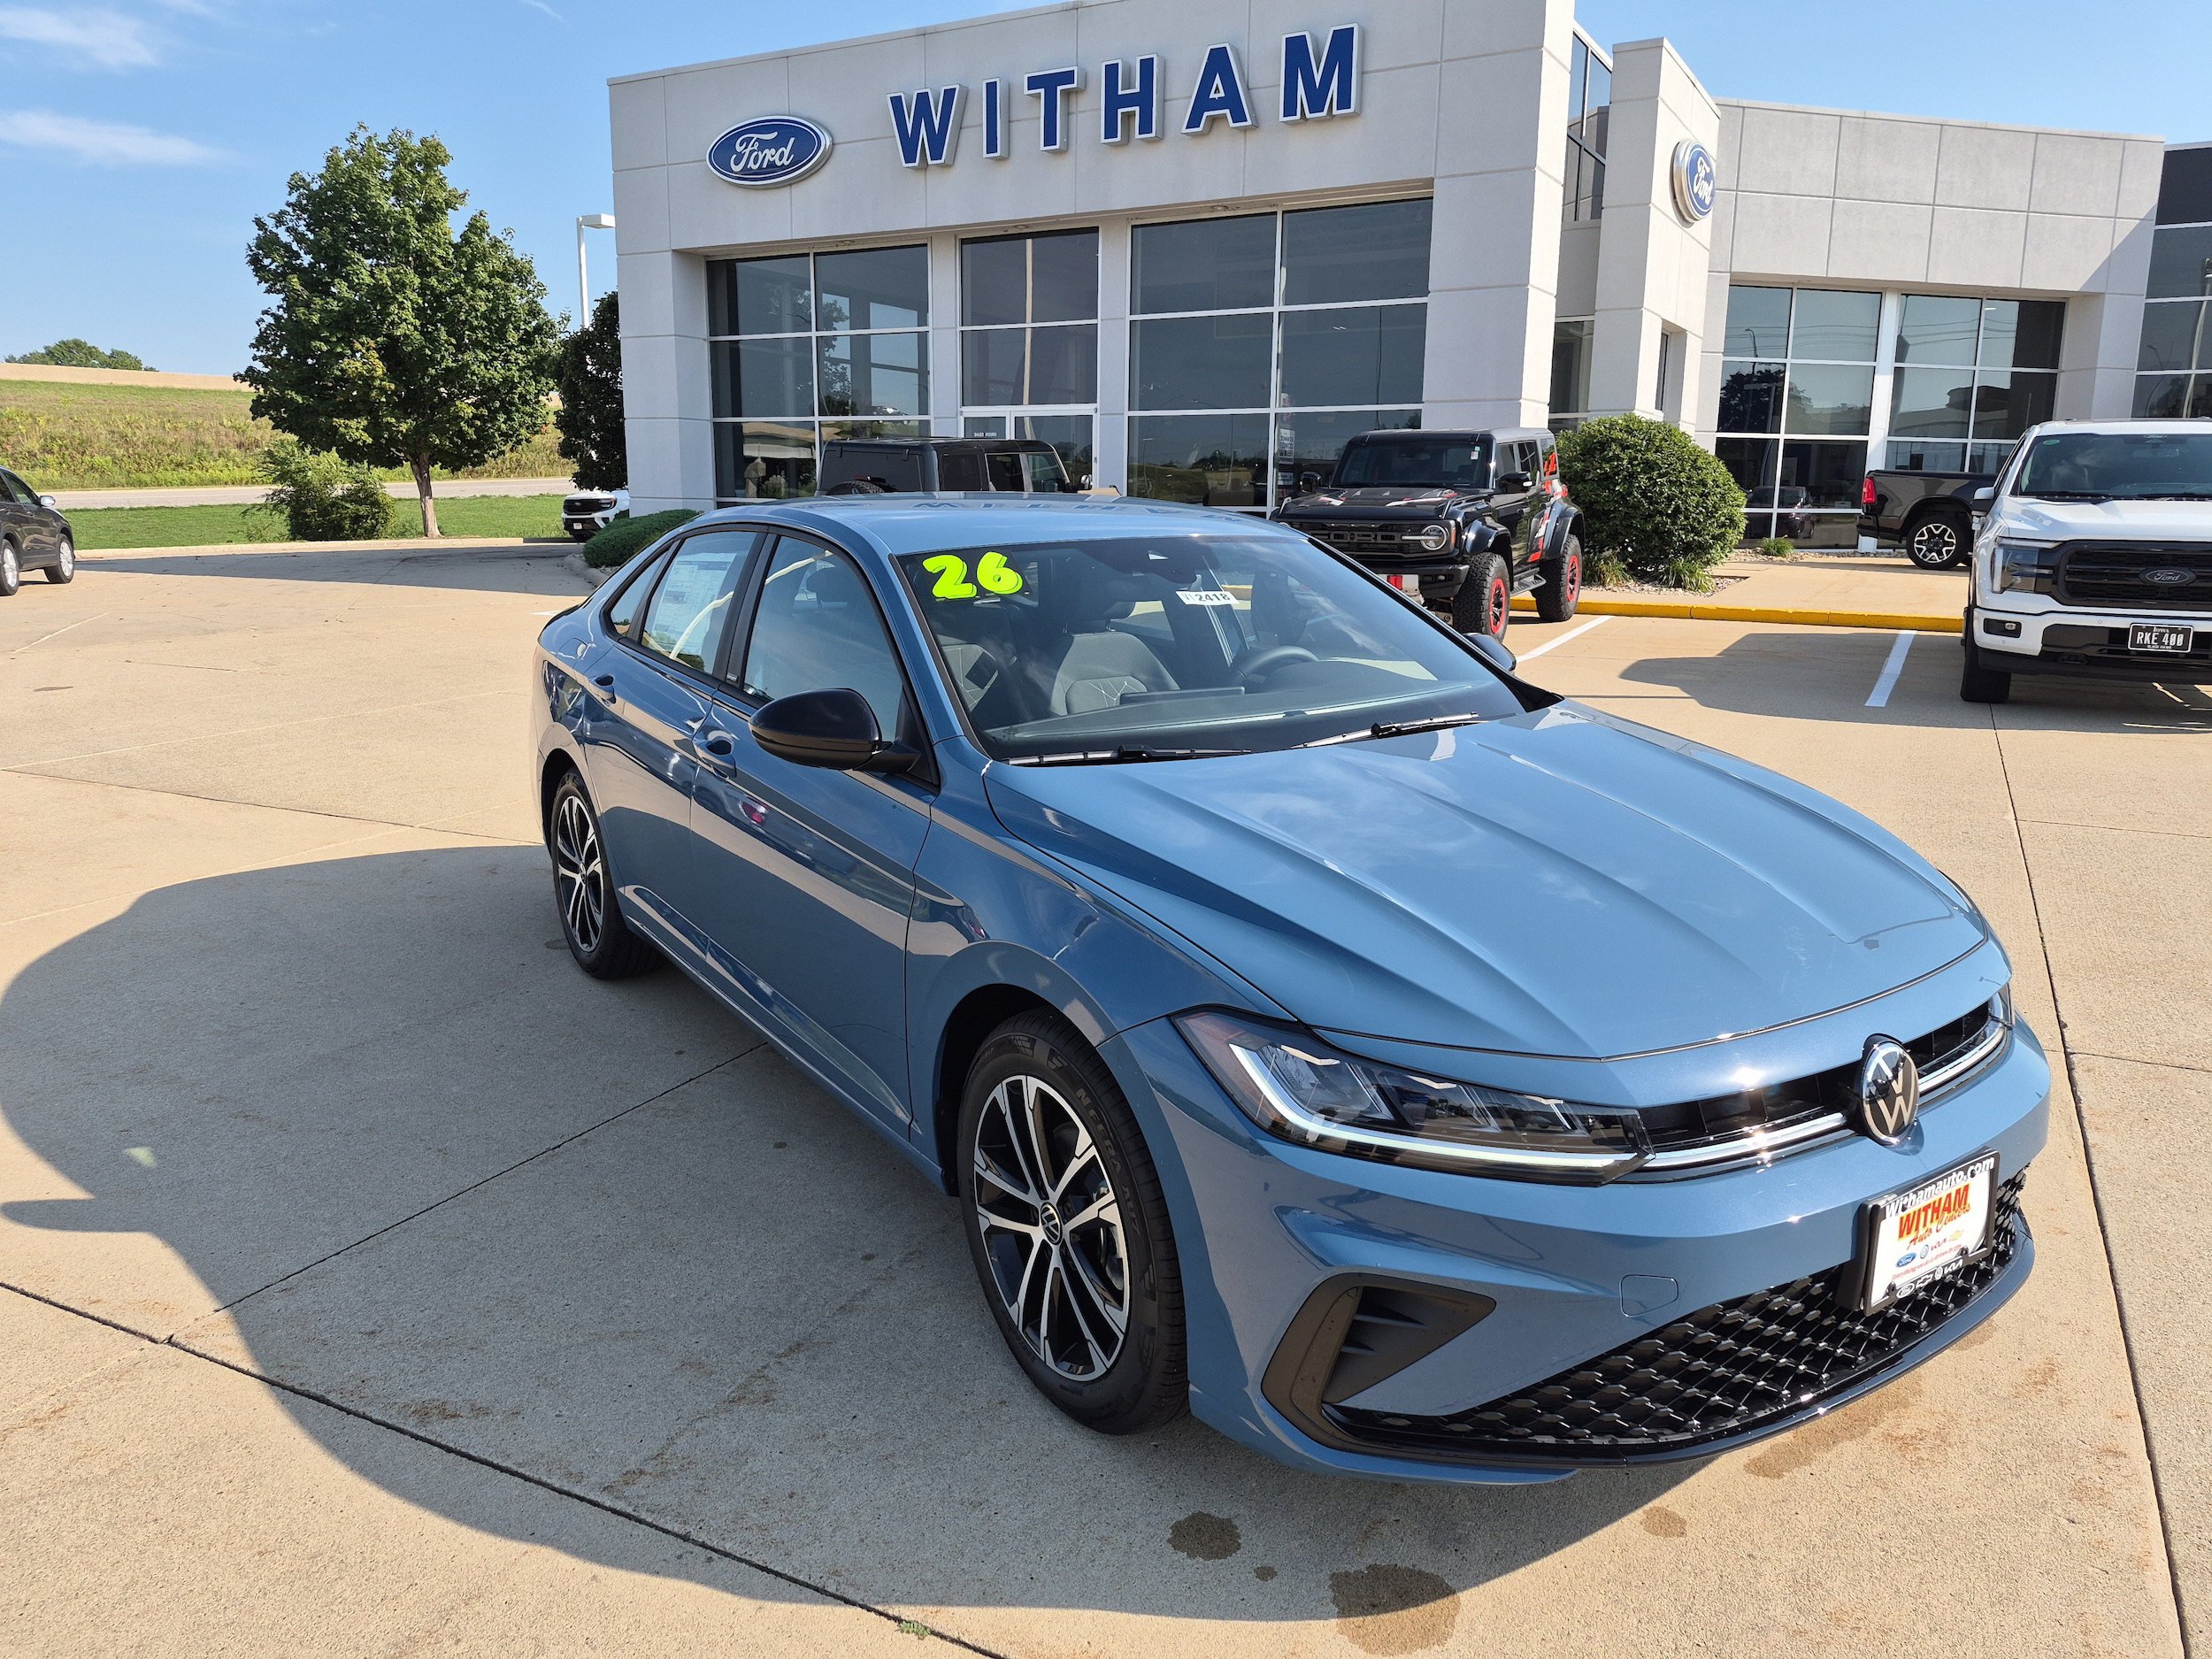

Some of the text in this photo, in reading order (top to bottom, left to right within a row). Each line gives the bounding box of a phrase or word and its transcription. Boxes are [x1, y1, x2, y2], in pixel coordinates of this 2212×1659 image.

[887, 23, 1362, 168] WITHAM
[730, 131, 795, 173] Ford
[923, 551, 1023, 599] 26
[2154, 572, 2181, 581] Ford
[2136, 631, 2184, 647] RKE 400
[1886, 1156, 1994, 1218] Withamauto.com
[1898, 1183, 1970, 1240] WITHAM
[1906, 1227, 1932, 1250] Auto
